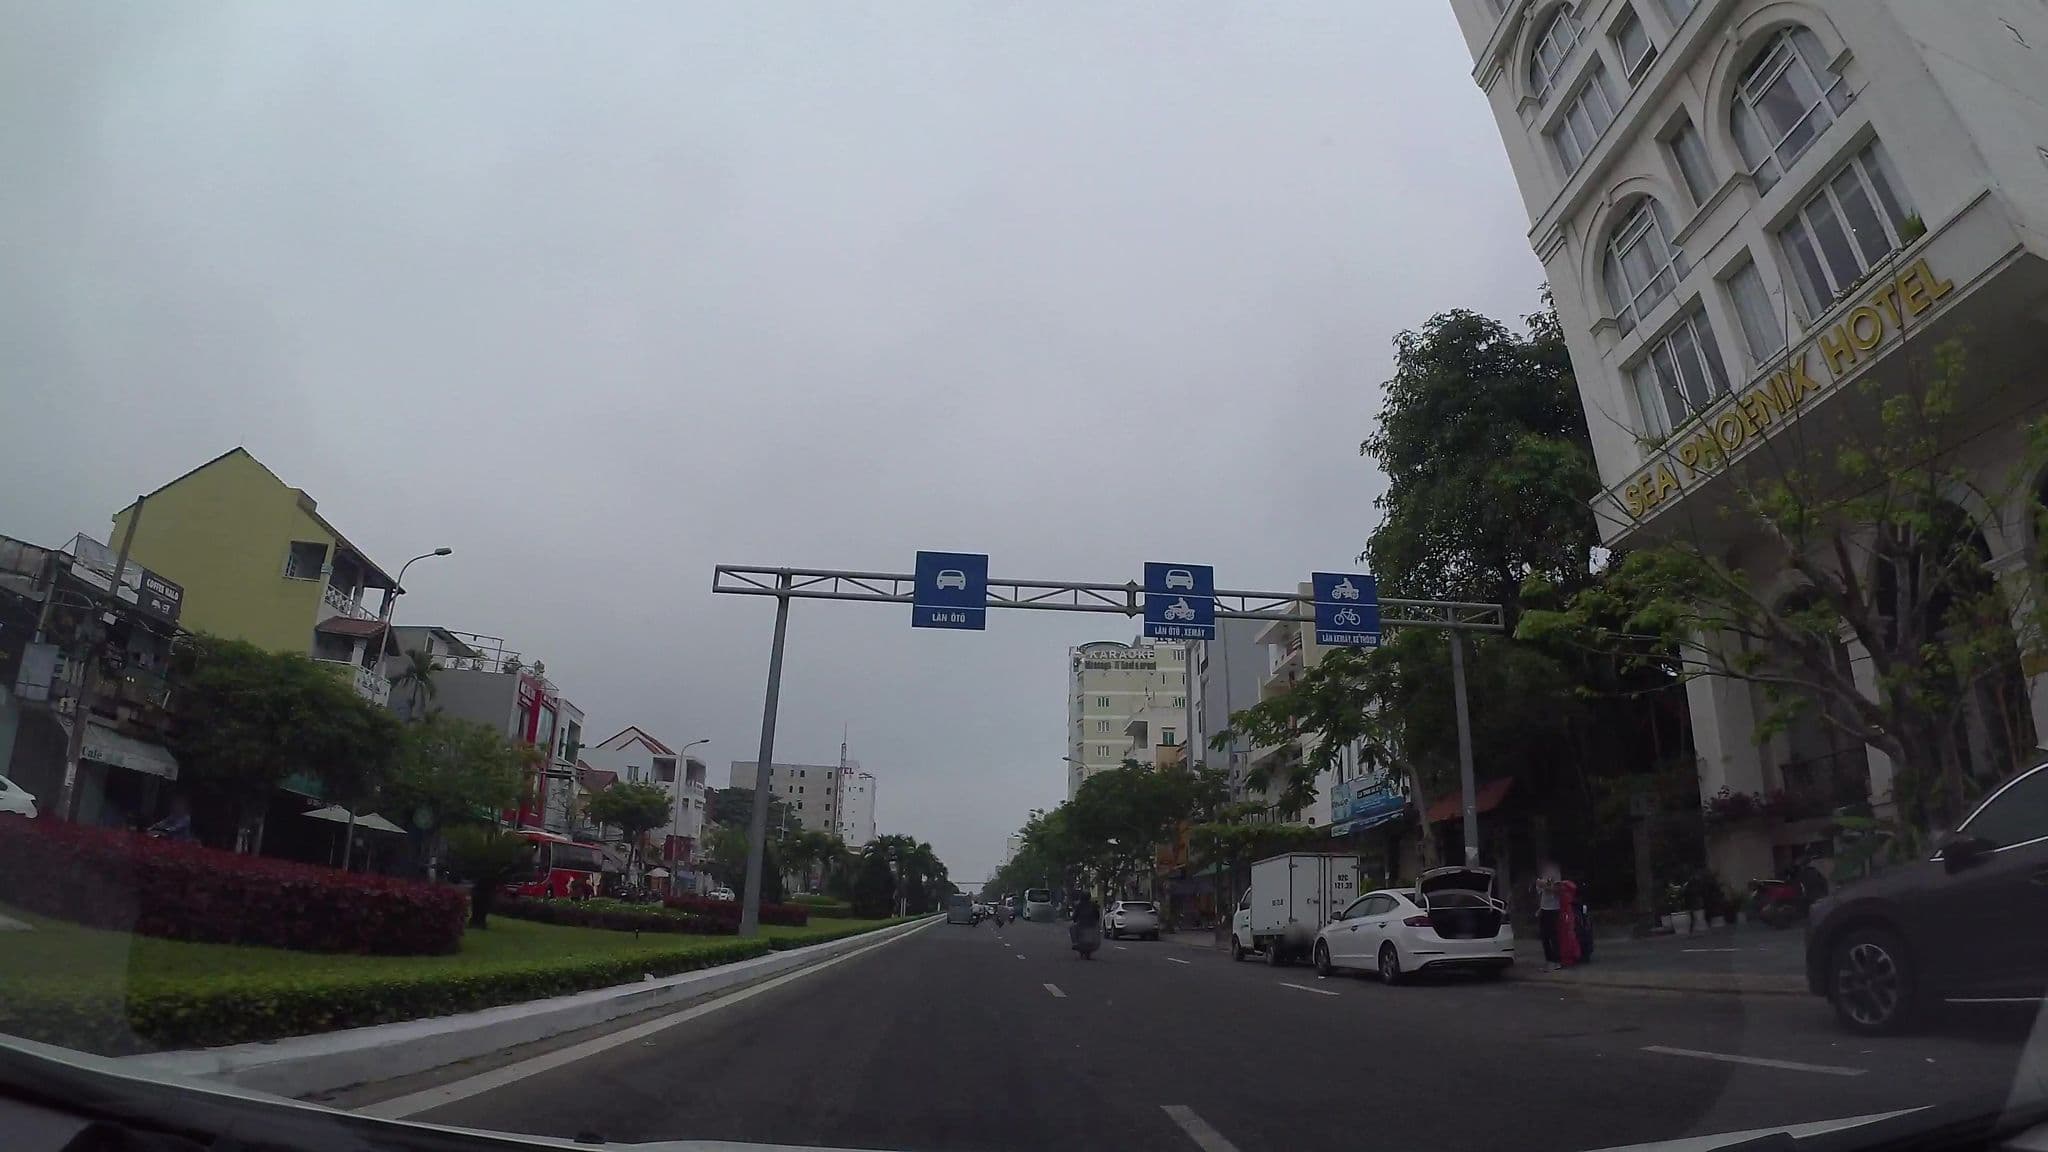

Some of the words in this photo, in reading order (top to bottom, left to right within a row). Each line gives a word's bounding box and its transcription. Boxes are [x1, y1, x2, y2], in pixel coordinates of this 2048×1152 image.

[1623, 460, 1680, 519] SEA
[1679, 351, 1821, 480] PHOENIX
[1816, 256, 1955, 375] HOTEL
[146, 578, 165, 594] COFFEE
[1089, 649, 1156, 660] KARAOKE
